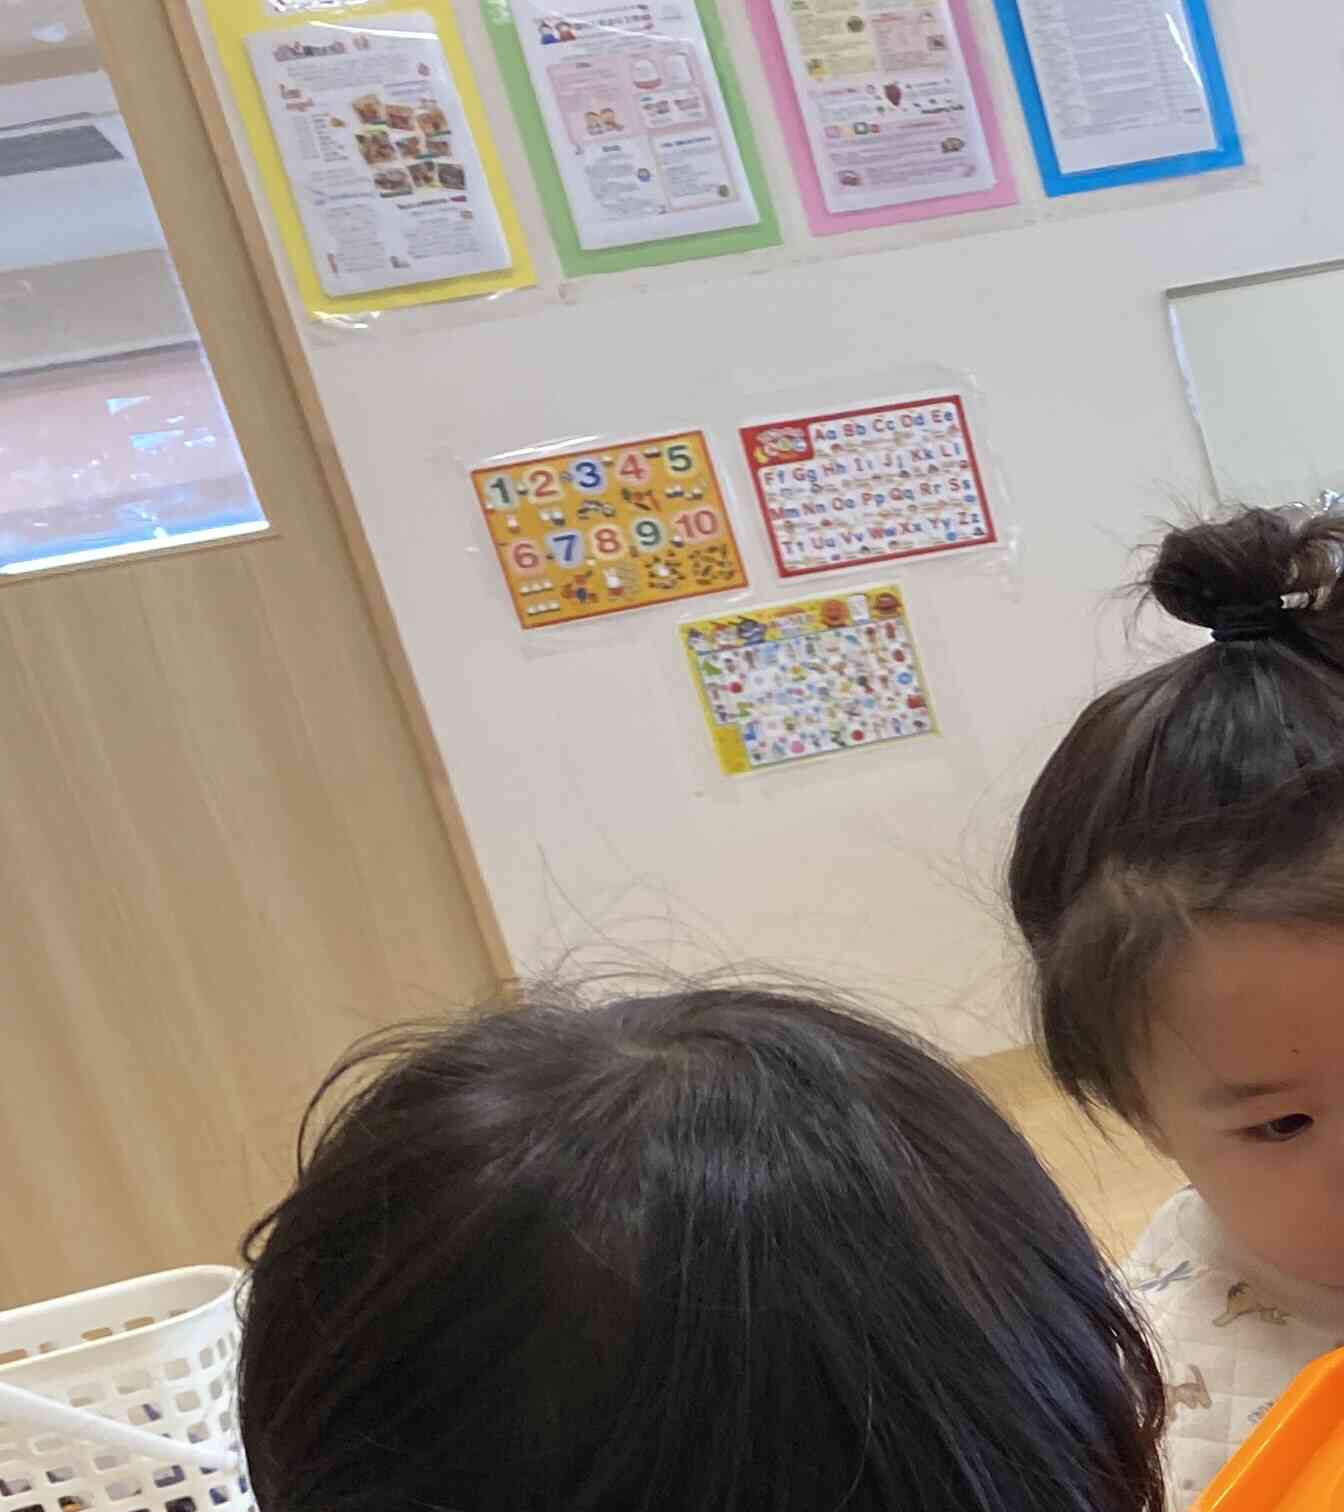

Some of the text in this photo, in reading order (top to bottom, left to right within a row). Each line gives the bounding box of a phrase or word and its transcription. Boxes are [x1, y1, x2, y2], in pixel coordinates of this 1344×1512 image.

[815, 429, 836, 440] Aa
[872, 419, 895, 432] Cc
[931, 410, 953, 423] Ee
[490, 446, 692, 504] 1 2 3 4 5
[764, 470, 784, 484] Ff
[793, 468, 817, 482] Gg
[824, 463, 847, 475] Hh
[802, 502, 826, 514] Nn
[863, 493, 885, 506] Pp
[920, 483, 942, 495] Rr
[949, 478, 970, 491] Ss
[513, 510, 717, 568] 6 7 8 9 10
[841, 532, 863, 544] Vv
[899, 522, 921, 534] Xx
[959, 512, 980, 525] Zz
